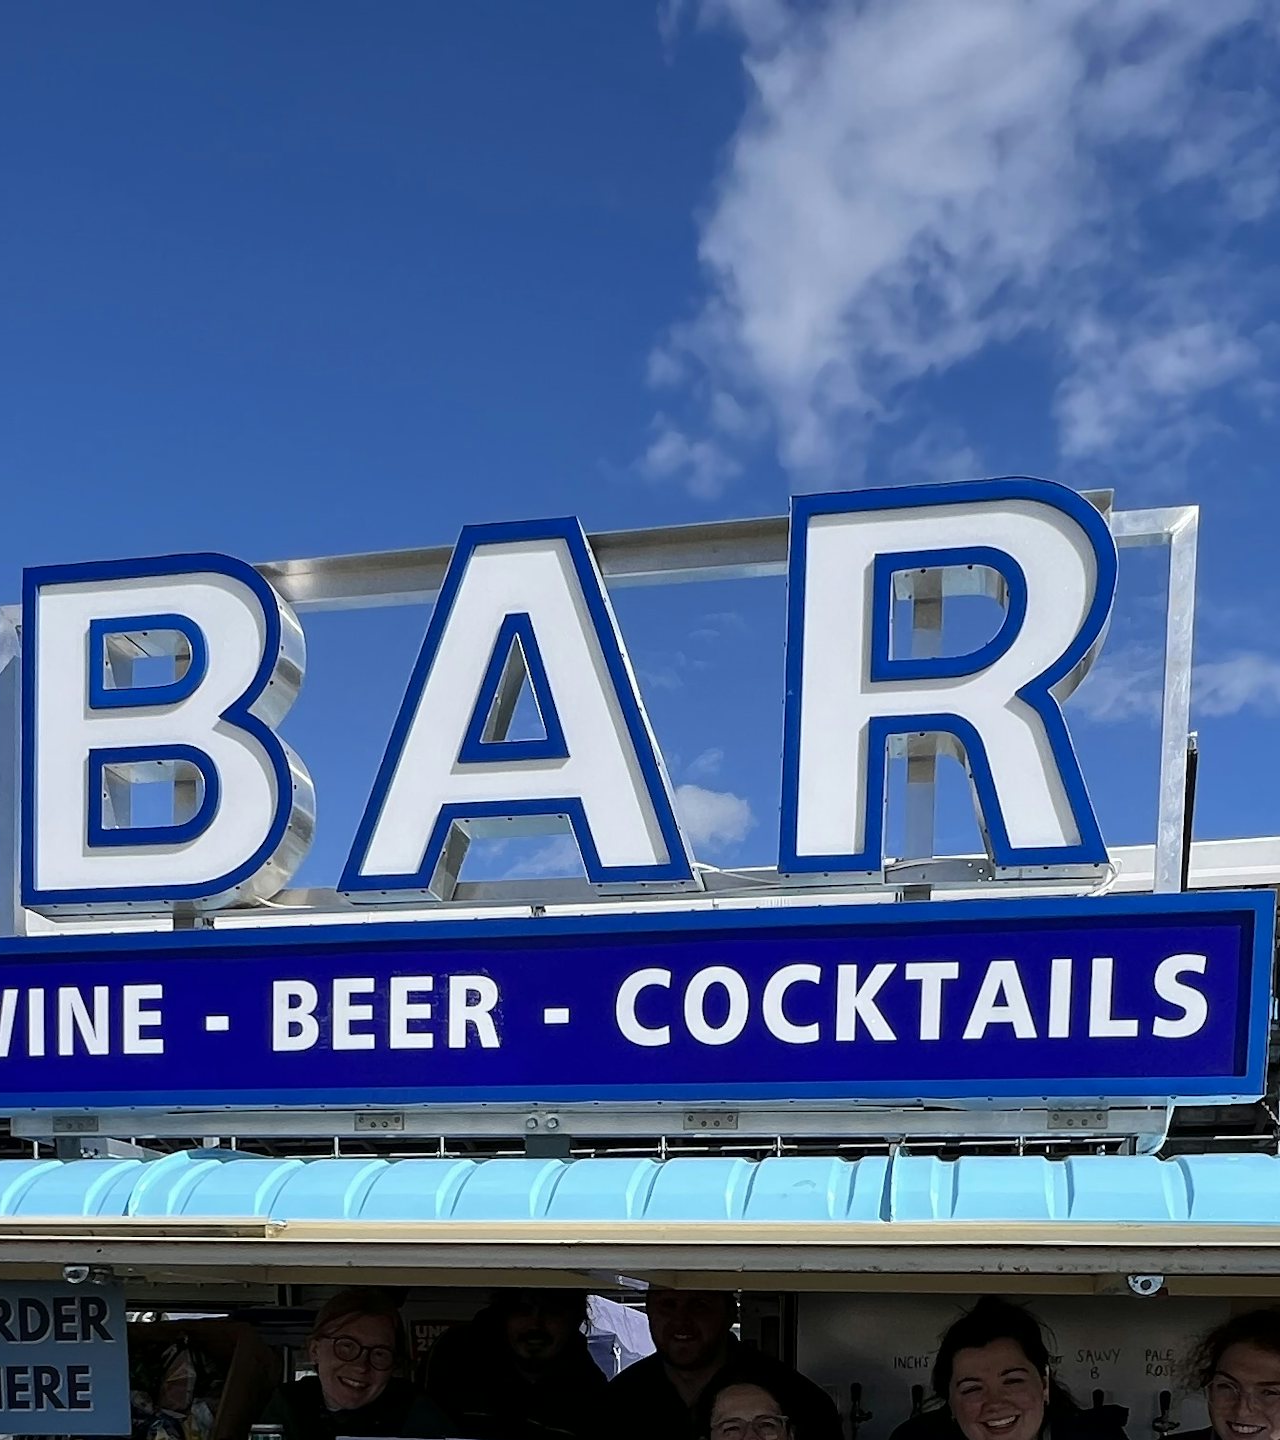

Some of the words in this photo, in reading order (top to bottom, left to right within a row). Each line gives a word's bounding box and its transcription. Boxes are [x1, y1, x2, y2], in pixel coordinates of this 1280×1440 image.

[20, 476, 1120, 914] BAR
[272, 974, 501, 1053] BEER
[614, 954, 1210, 1047] COCKTAILS
[1076, 1349, 1121, 1364] SAUVY
[1145, 1349, 1174, 1362] PALE
